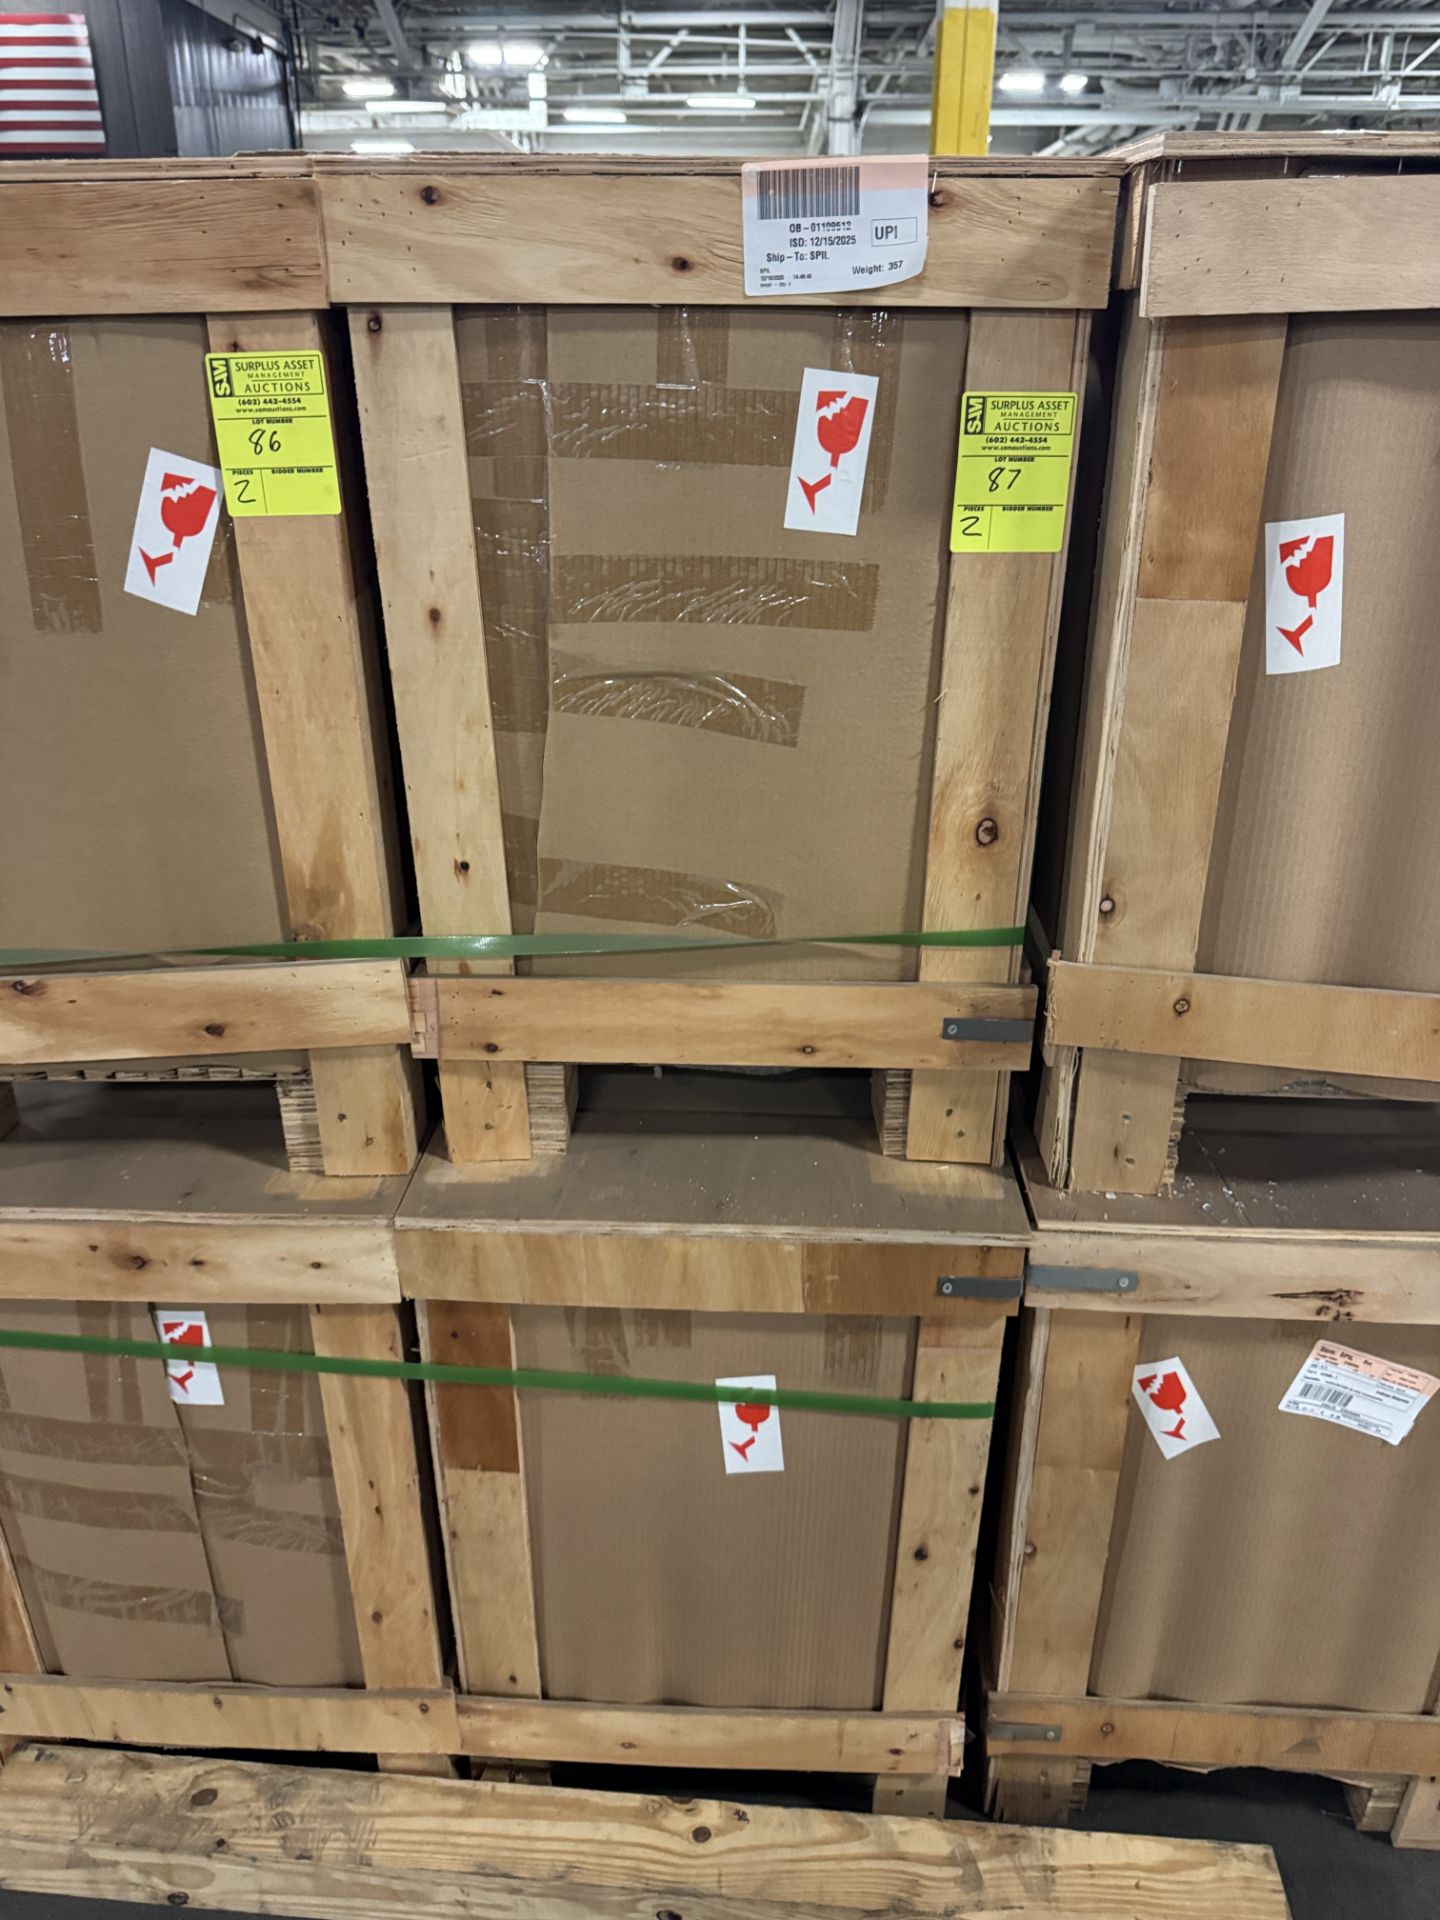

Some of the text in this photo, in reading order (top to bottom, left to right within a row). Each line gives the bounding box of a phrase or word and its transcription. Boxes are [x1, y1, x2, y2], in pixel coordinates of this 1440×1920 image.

[875, 225, 898, 240] UPI
[789, 235, 857, 247] ISD: 12/15/2025
[809, 250, 830, 260] SPIL
[852, 260, 904, 275] Weight: 357
[235, 360, 314, 372] SURPLUS ASSET
[247, 371, 305, 379] MANAGEMENT
[244, 382, 311, 393] AUCTIONS
[238, 397, 301, 406] (602) 442-4554
[990, 400, 1069, 410] SURPLUS ASSET
[994, 422, 1060, 432] AUCTIONS
[249, 428, 281, 455] 86
[986, 436, 1048, 444] (602) 442-4554
[988, 466, 1022, 492] 87
[234, 480, 256, 503] 2
[960, 516, 982, 537] 2
